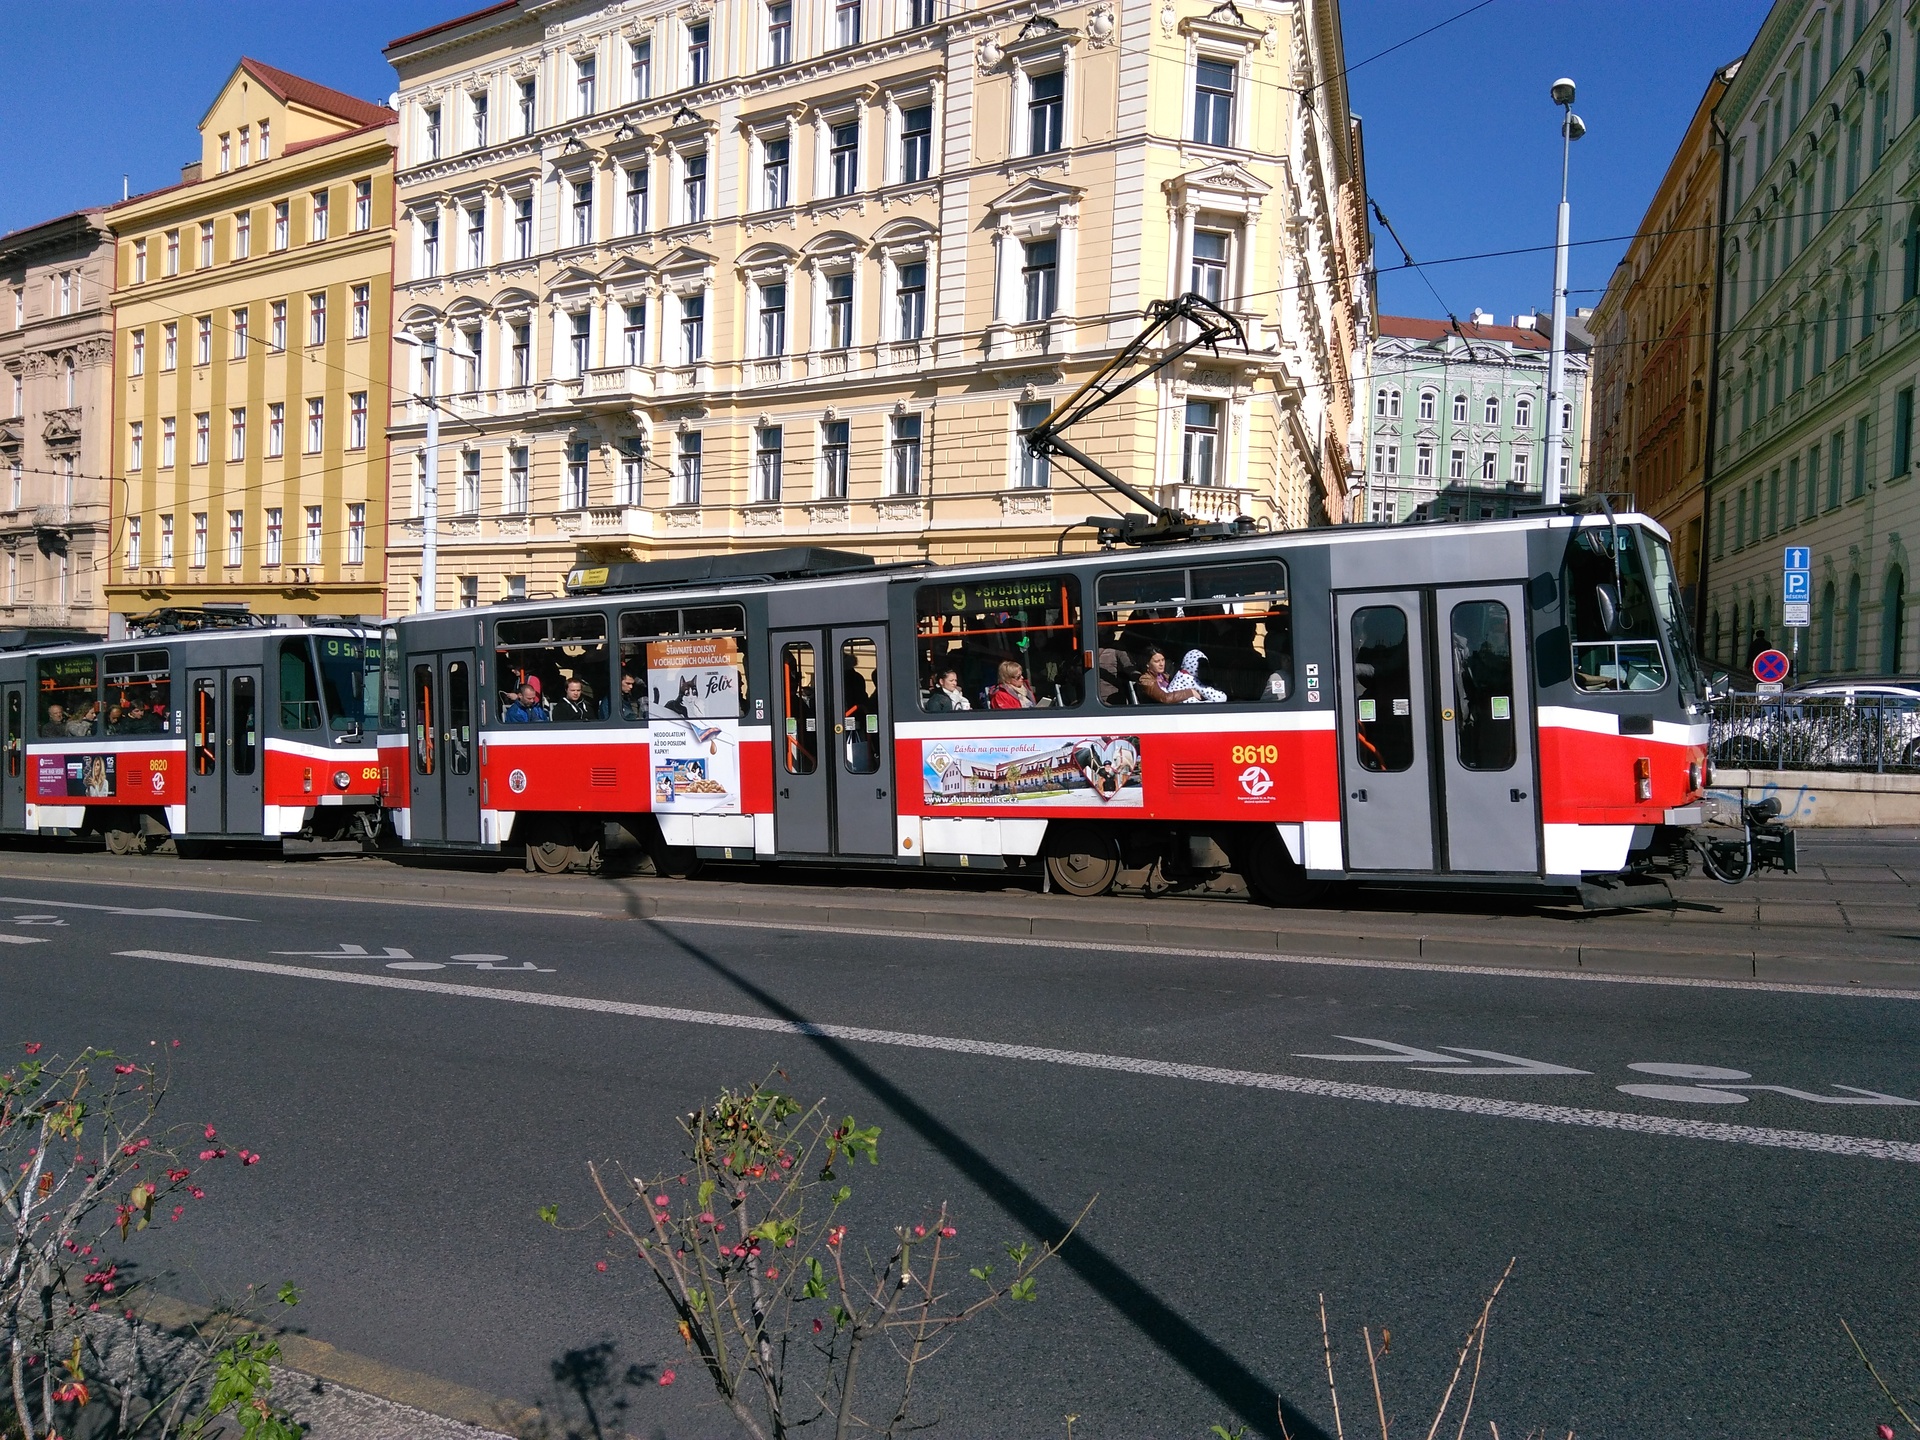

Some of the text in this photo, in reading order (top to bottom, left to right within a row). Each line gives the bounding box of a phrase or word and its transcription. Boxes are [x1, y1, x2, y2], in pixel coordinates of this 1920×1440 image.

[1789, 574, 1804, 593] P
[952, 587, 967, 610] 9
[984, 594, 1045, 608] Husinecká
[327, 640, 339, 656] 9
[693, 644, 717, 654] KOUSKY
[653, 659, 658, 667] V
[697, 653, 731, 665] OMÁČKÁCH
[953, 744, 976, 753] Láska
[989, 744, 1009, 755] první
[1231, 744, 1278, 764] 8619
[149, 759, 168, 771] 8620
